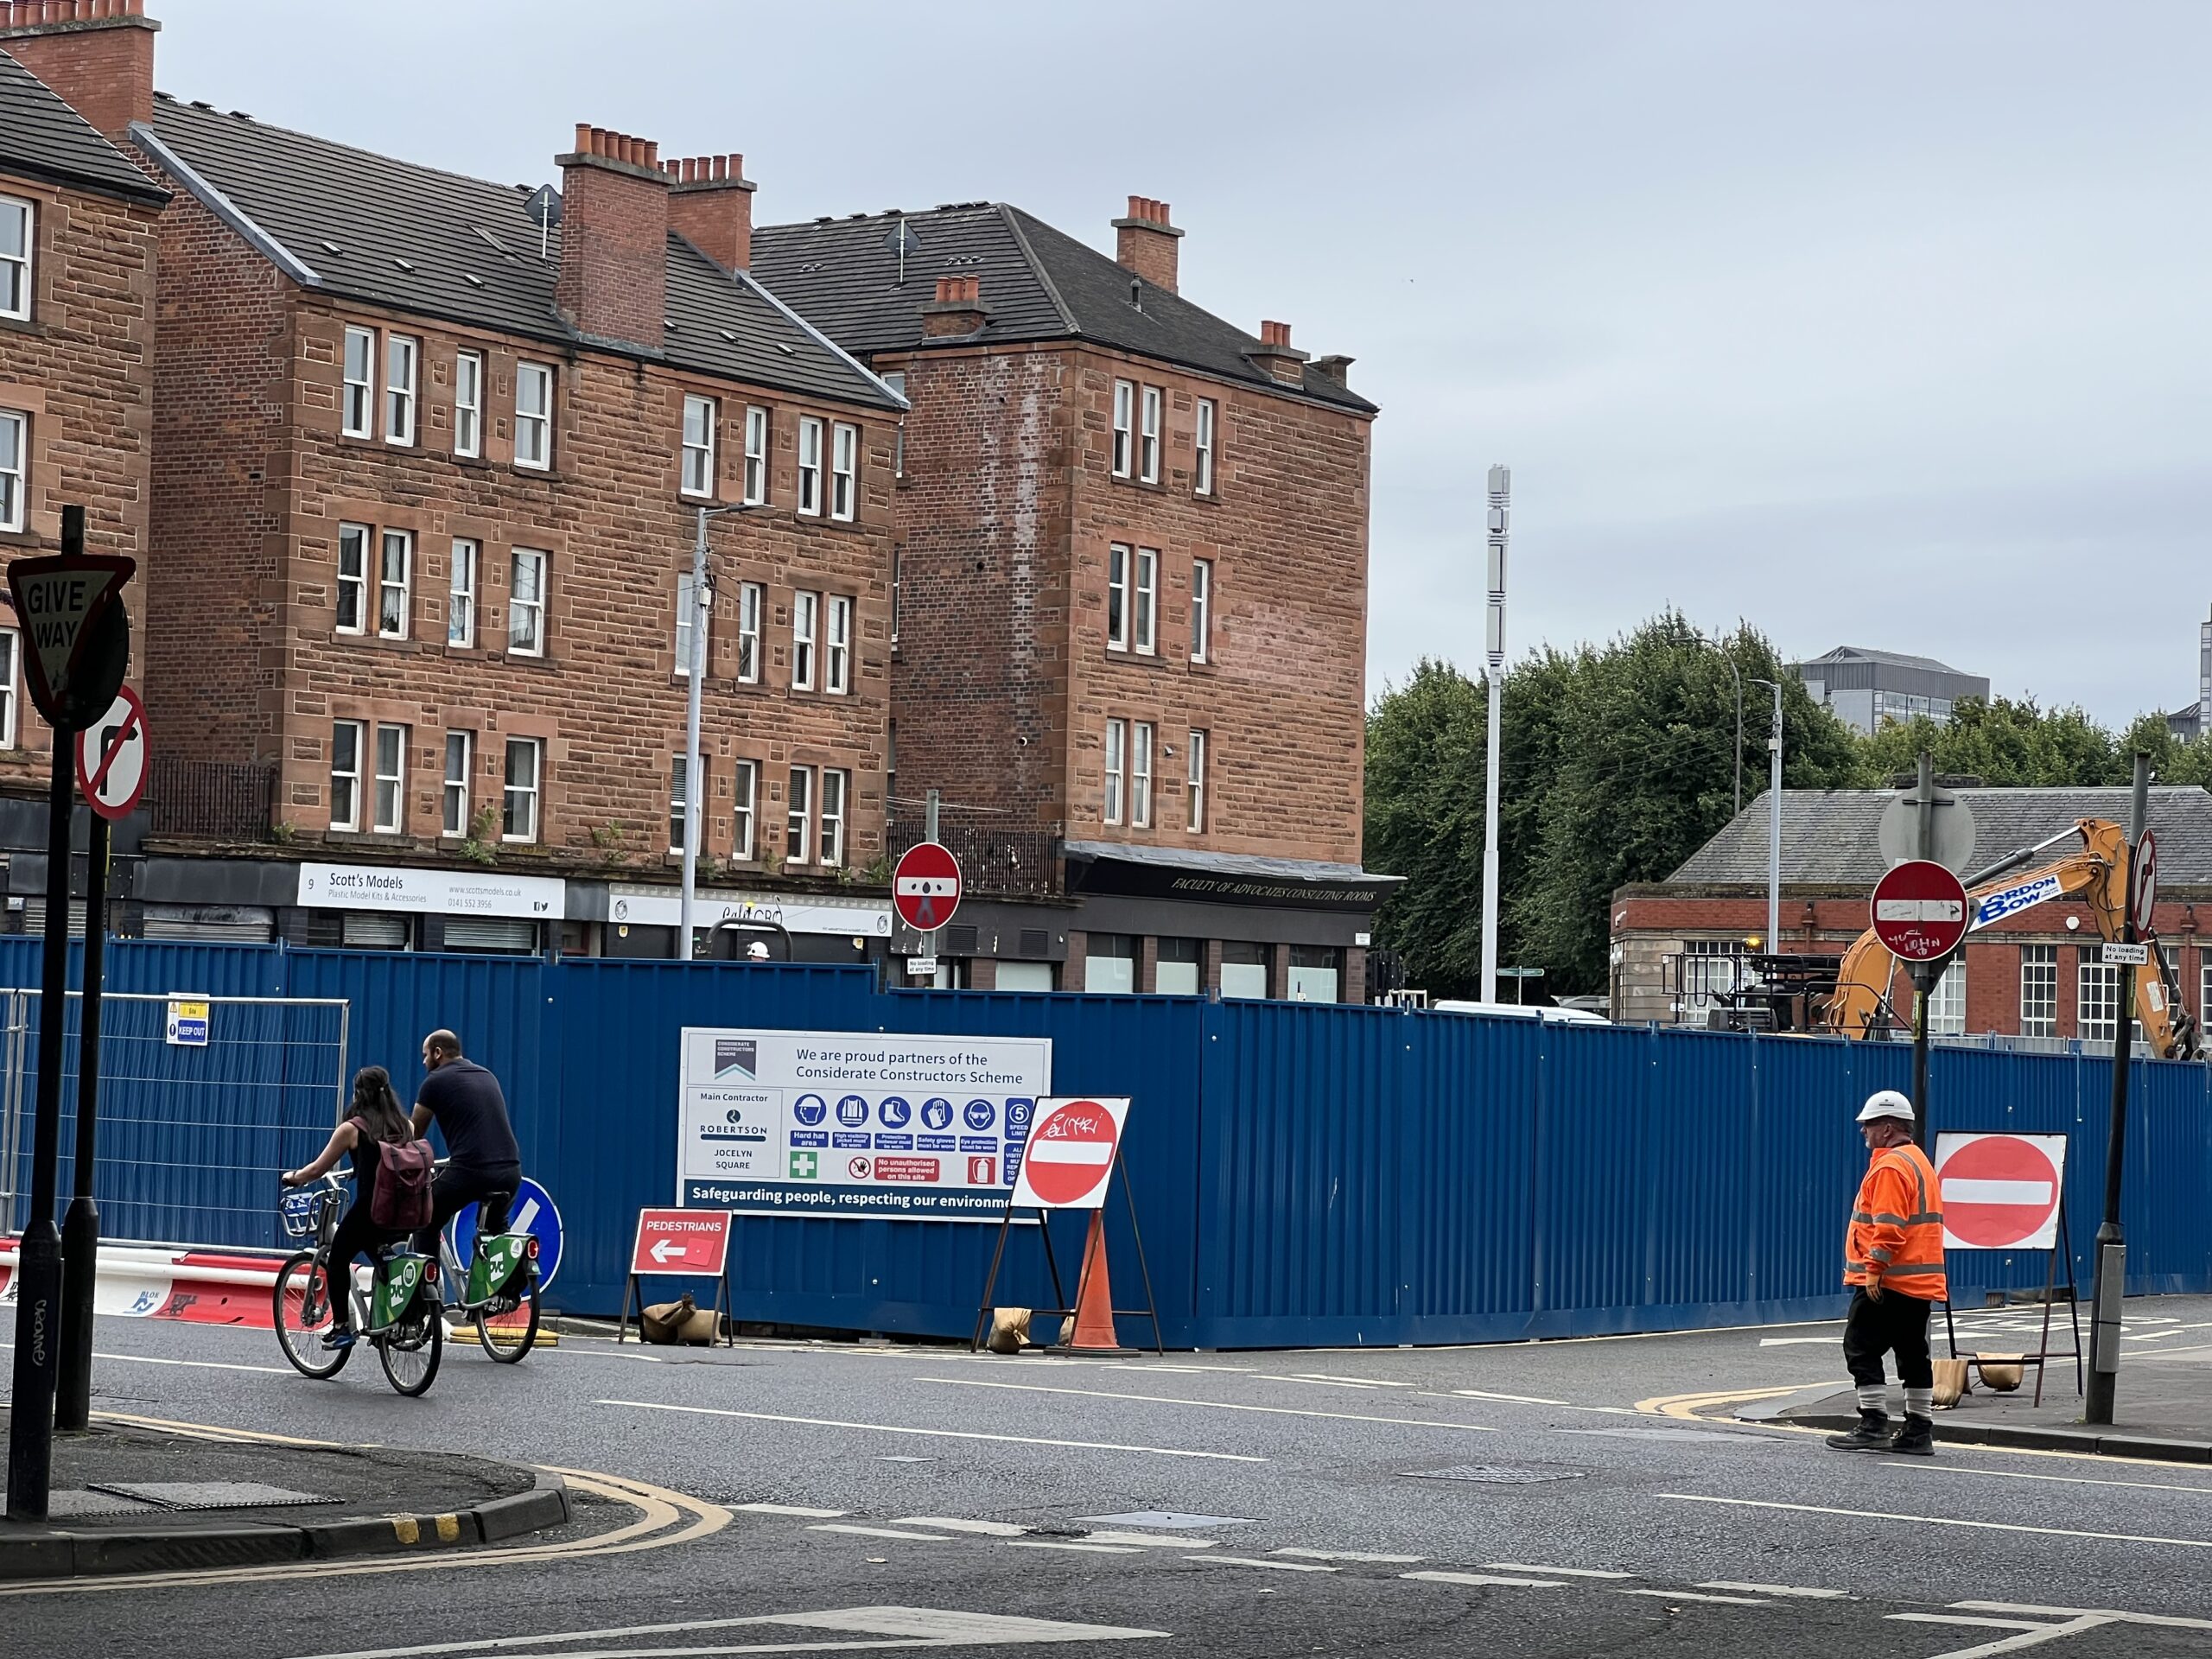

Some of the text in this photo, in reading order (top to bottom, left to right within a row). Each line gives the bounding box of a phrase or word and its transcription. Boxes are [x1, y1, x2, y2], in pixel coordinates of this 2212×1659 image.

[28, 581, 86, 614] GIVE
[35, 620, 79, 649] WAY
[308, 878, 315, 889] 9
[366, 875, 404, 889] Models
[328, 889, 349, 899] Plastic
[350, 891, 371, 900] Model
[372, 892, 384, 900] Kits
[391, 893, 427, 903] Accessories
[448, 887, 522, 897] www.scottsmodels.co.uk
[1171, 878, 1376, 902] FACULTY OF ADVOCATES CONSULTING ROOMS
[448, 899, 492, 909] 0141 552 3956
[178, 1027, 205, 1036] KEEP OUT
[797, 1049, 988, 1065] We are proud partners of the
[796, 1066, 1023, 1084] Considerate Constructors Scheme
[1014, 1107, 1025, 1121] 5
[700, 1125, 767, 1135] ROBERTSON
[714, 1149, 752, 1158] JOCELYN
[715, 1161, 750, 1170] SQUARE
[692, 1187, 1009, 1208] Safeguarding people, respecting our environme
[646, 1221, 721, 1232] PEDESTRIANS
